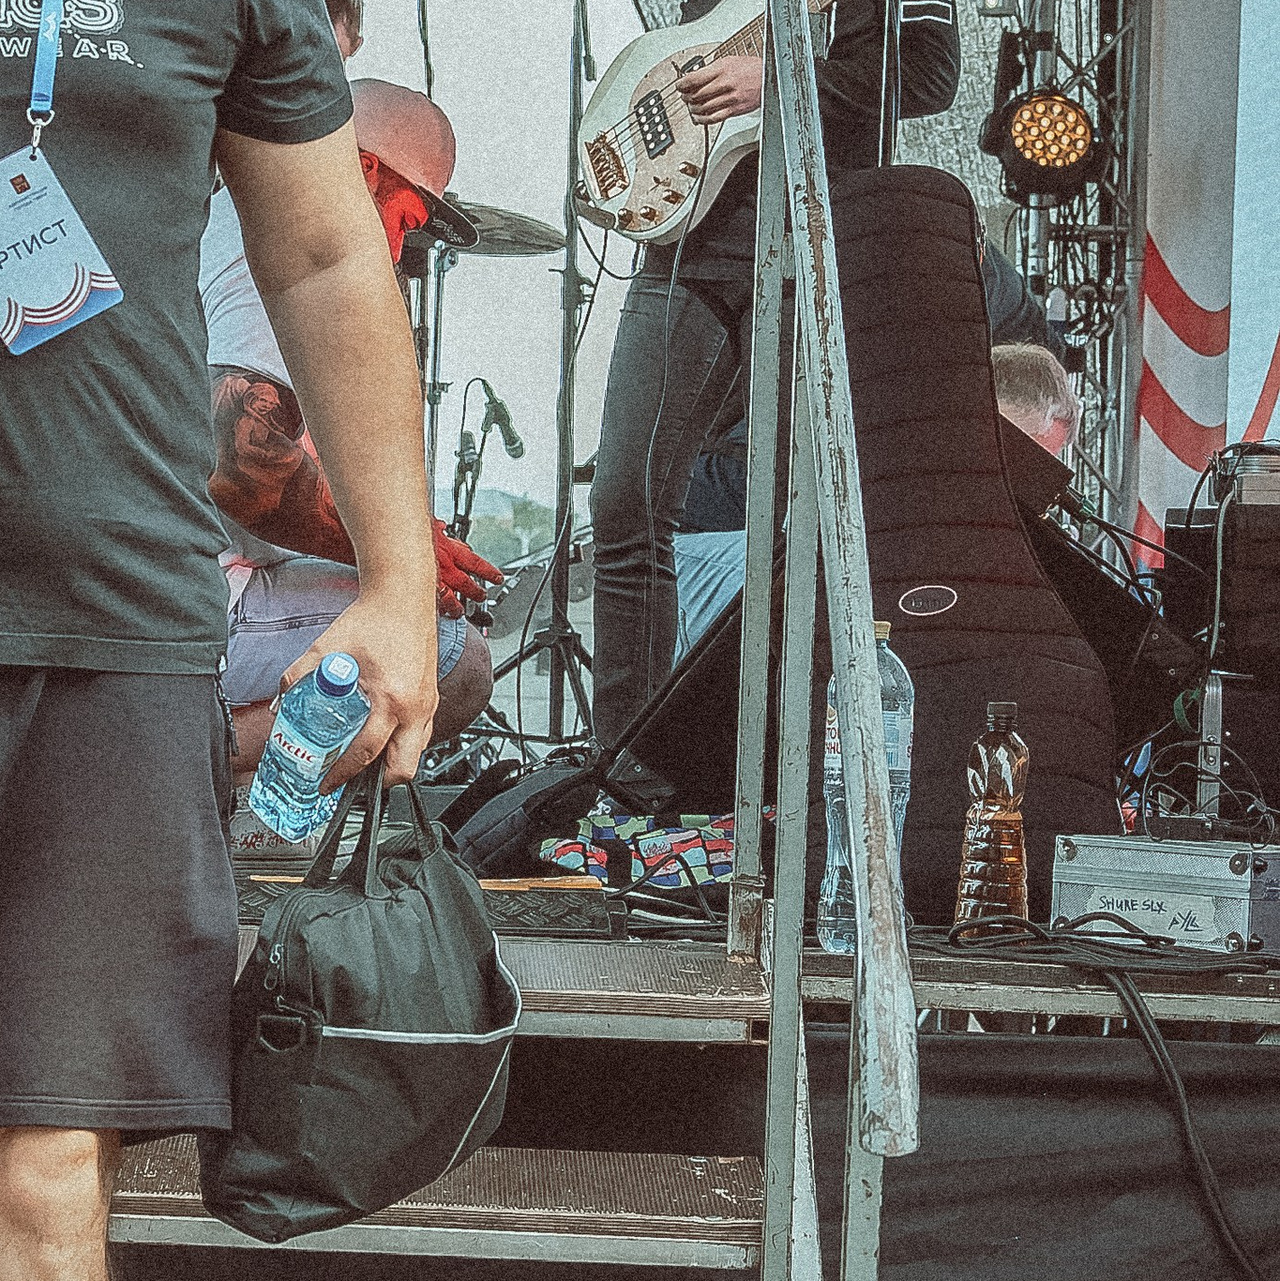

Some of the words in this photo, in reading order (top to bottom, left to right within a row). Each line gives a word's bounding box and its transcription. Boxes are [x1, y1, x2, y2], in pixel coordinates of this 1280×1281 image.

[273, 732, 316, 763] Arctic
[1099, 895, 1139, 912] SHURE
[1141, 899, 1168, 914] SLX
